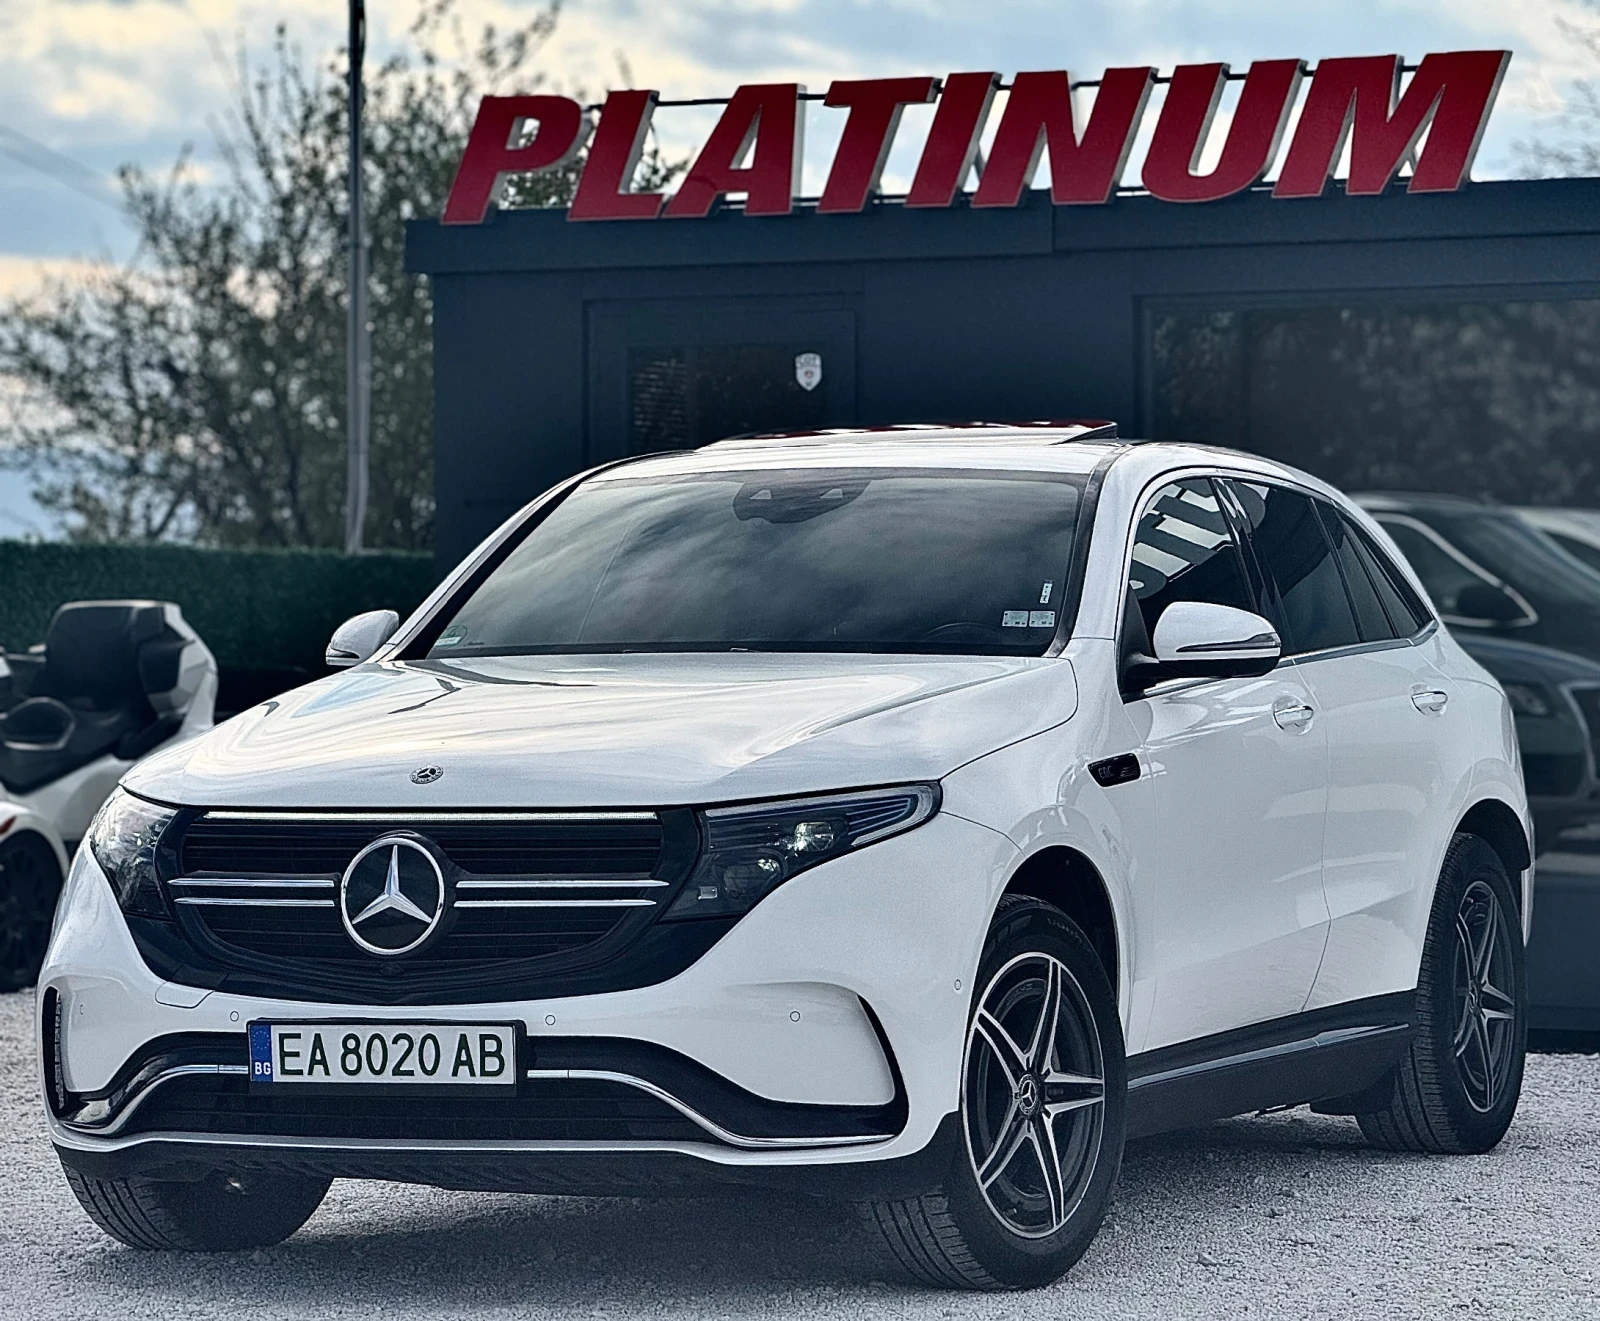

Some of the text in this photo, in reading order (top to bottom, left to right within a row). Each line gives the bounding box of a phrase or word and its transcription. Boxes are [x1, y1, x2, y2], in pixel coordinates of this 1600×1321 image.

[441, 49, 1512, 225] PLATINUM
[254, 1061, 272, 1075] BG
[278, 1032, 506, 1077] EA 8020 AB
